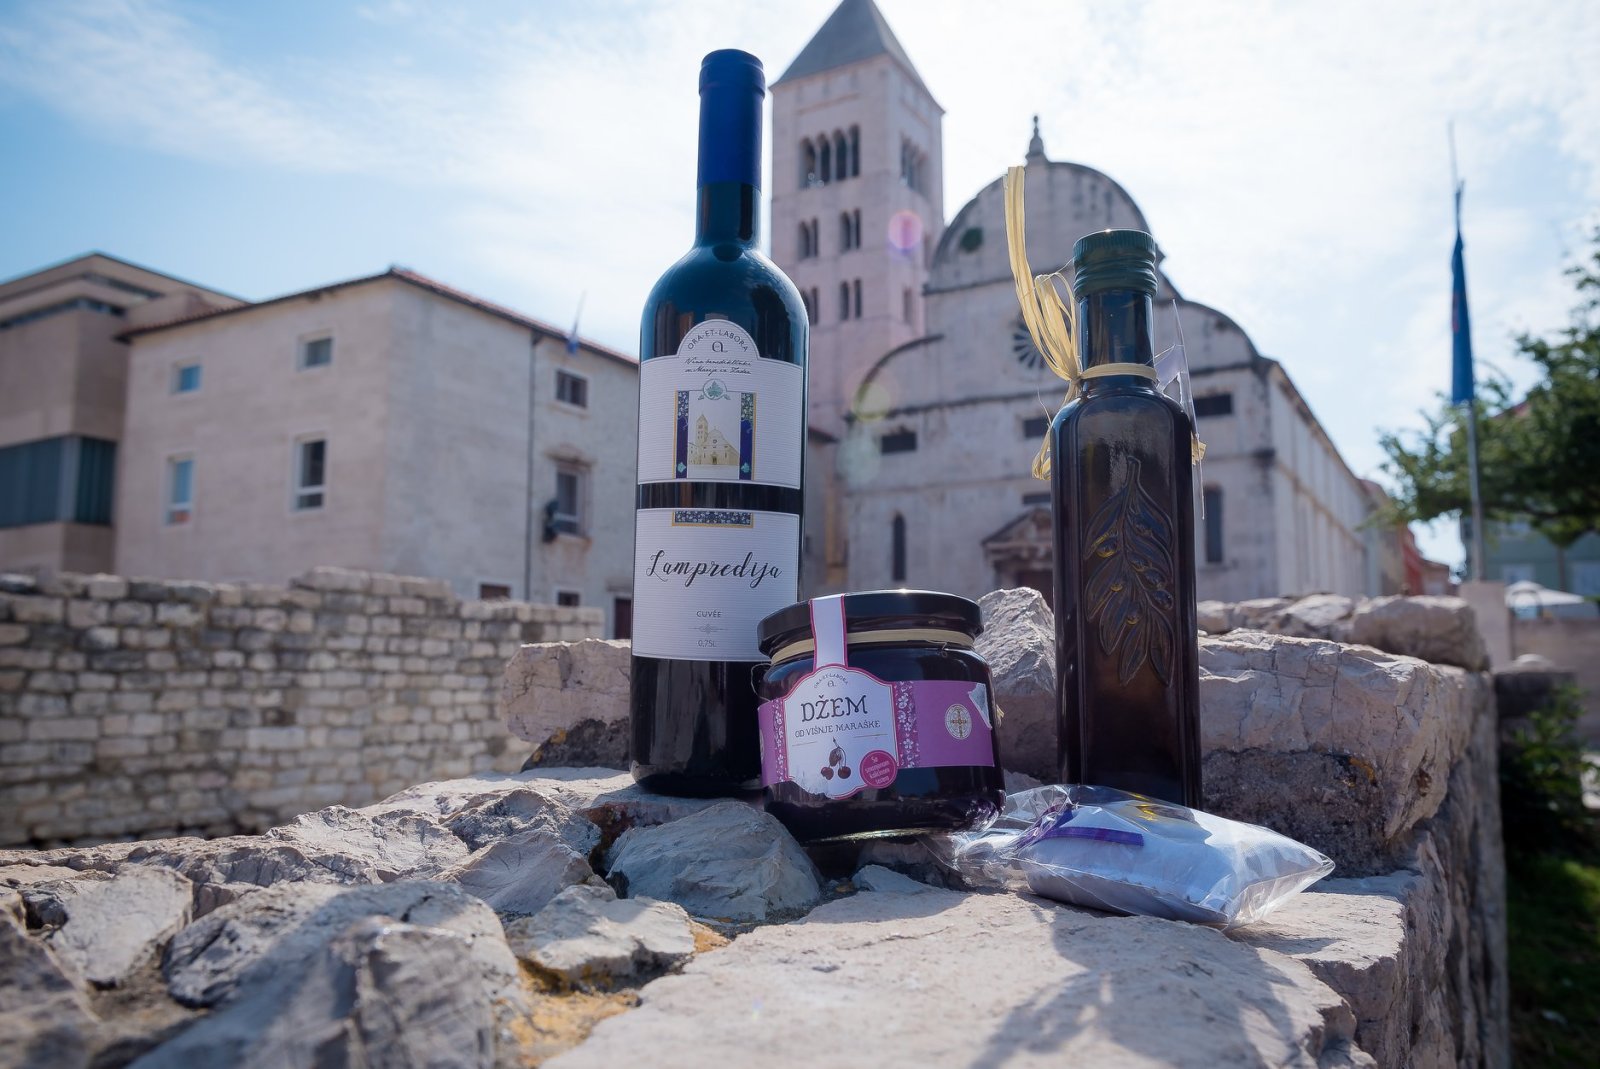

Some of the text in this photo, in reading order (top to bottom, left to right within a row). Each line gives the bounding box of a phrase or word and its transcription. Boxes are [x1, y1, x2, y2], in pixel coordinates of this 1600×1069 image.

[646, 550, 782, 588] Lampredija
[696, 609, 722, 618] CUVÉE
[800, 694, 868, 722] DŽEM
[795, 719, 881, 738] OD VIŠNJE MARAŠKE
